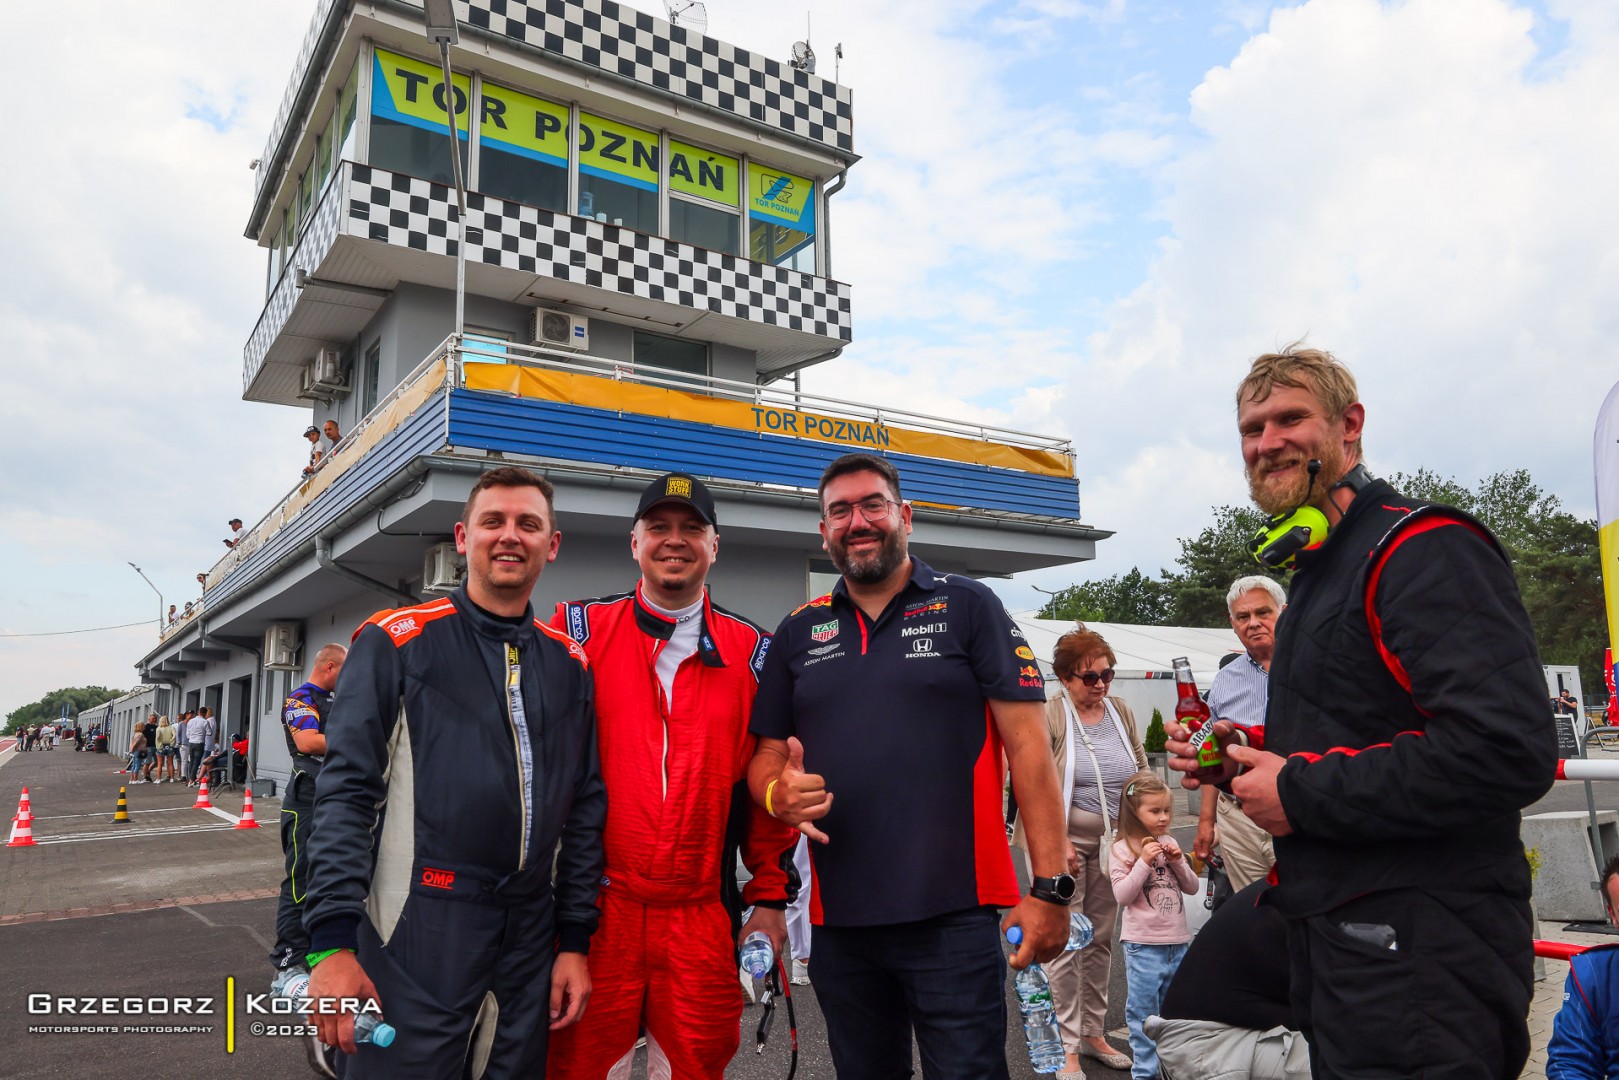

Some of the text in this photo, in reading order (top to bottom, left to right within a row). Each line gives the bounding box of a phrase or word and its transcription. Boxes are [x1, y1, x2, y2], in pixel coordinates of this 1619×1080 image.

[395, 67, 724, 192] TOR POZNAŃ
[755, 197, 799, 216] TOR POZNAŃ
[751, 407, 890, 446] TOR POZNAŃ
[668, 486, 690, 495] STUFF
[669, 480, 690, 488] WORK
[390, 619, 416, 635] OMP
[814, 622, 837, 633] TAG
[901, 624, 934, 637] Mobil
[1019, 678, 1034, 687] Red
[1190, 721, 1214, 748] MBAR
[422, 870, 455, 887] OMP
